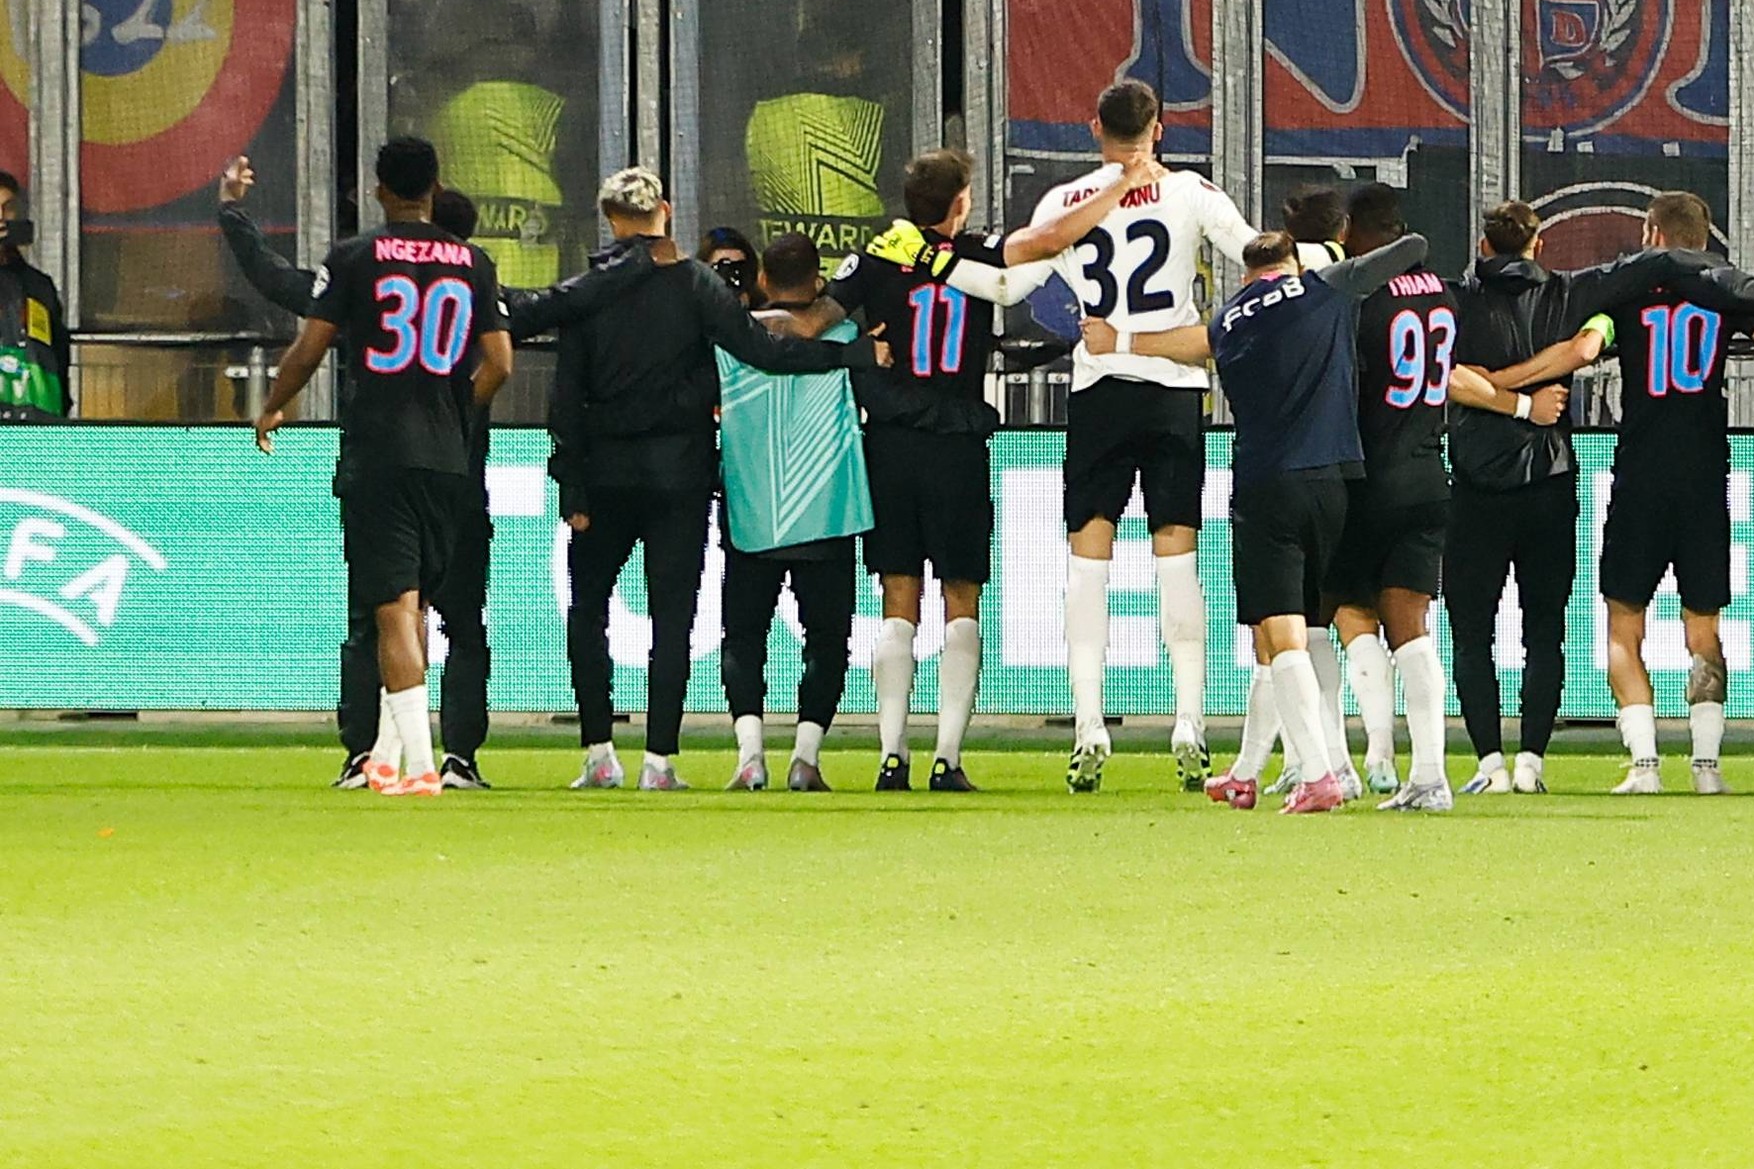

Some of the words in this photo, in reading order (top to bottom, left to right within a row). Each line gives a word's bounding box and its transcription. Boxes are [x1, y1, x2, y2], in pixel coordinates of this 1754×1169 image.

[374, 237, 474, 269] NGEZANA
[1073, 218, 1174, 319] 32
[1388, 272, 1443, 297] THIAM
[365, 274, 474, 376] 30
[908, 282, 968, 377] 11
[1384, 306, 1458, 410] 93
[1641, 301, 1721, 398] 10
